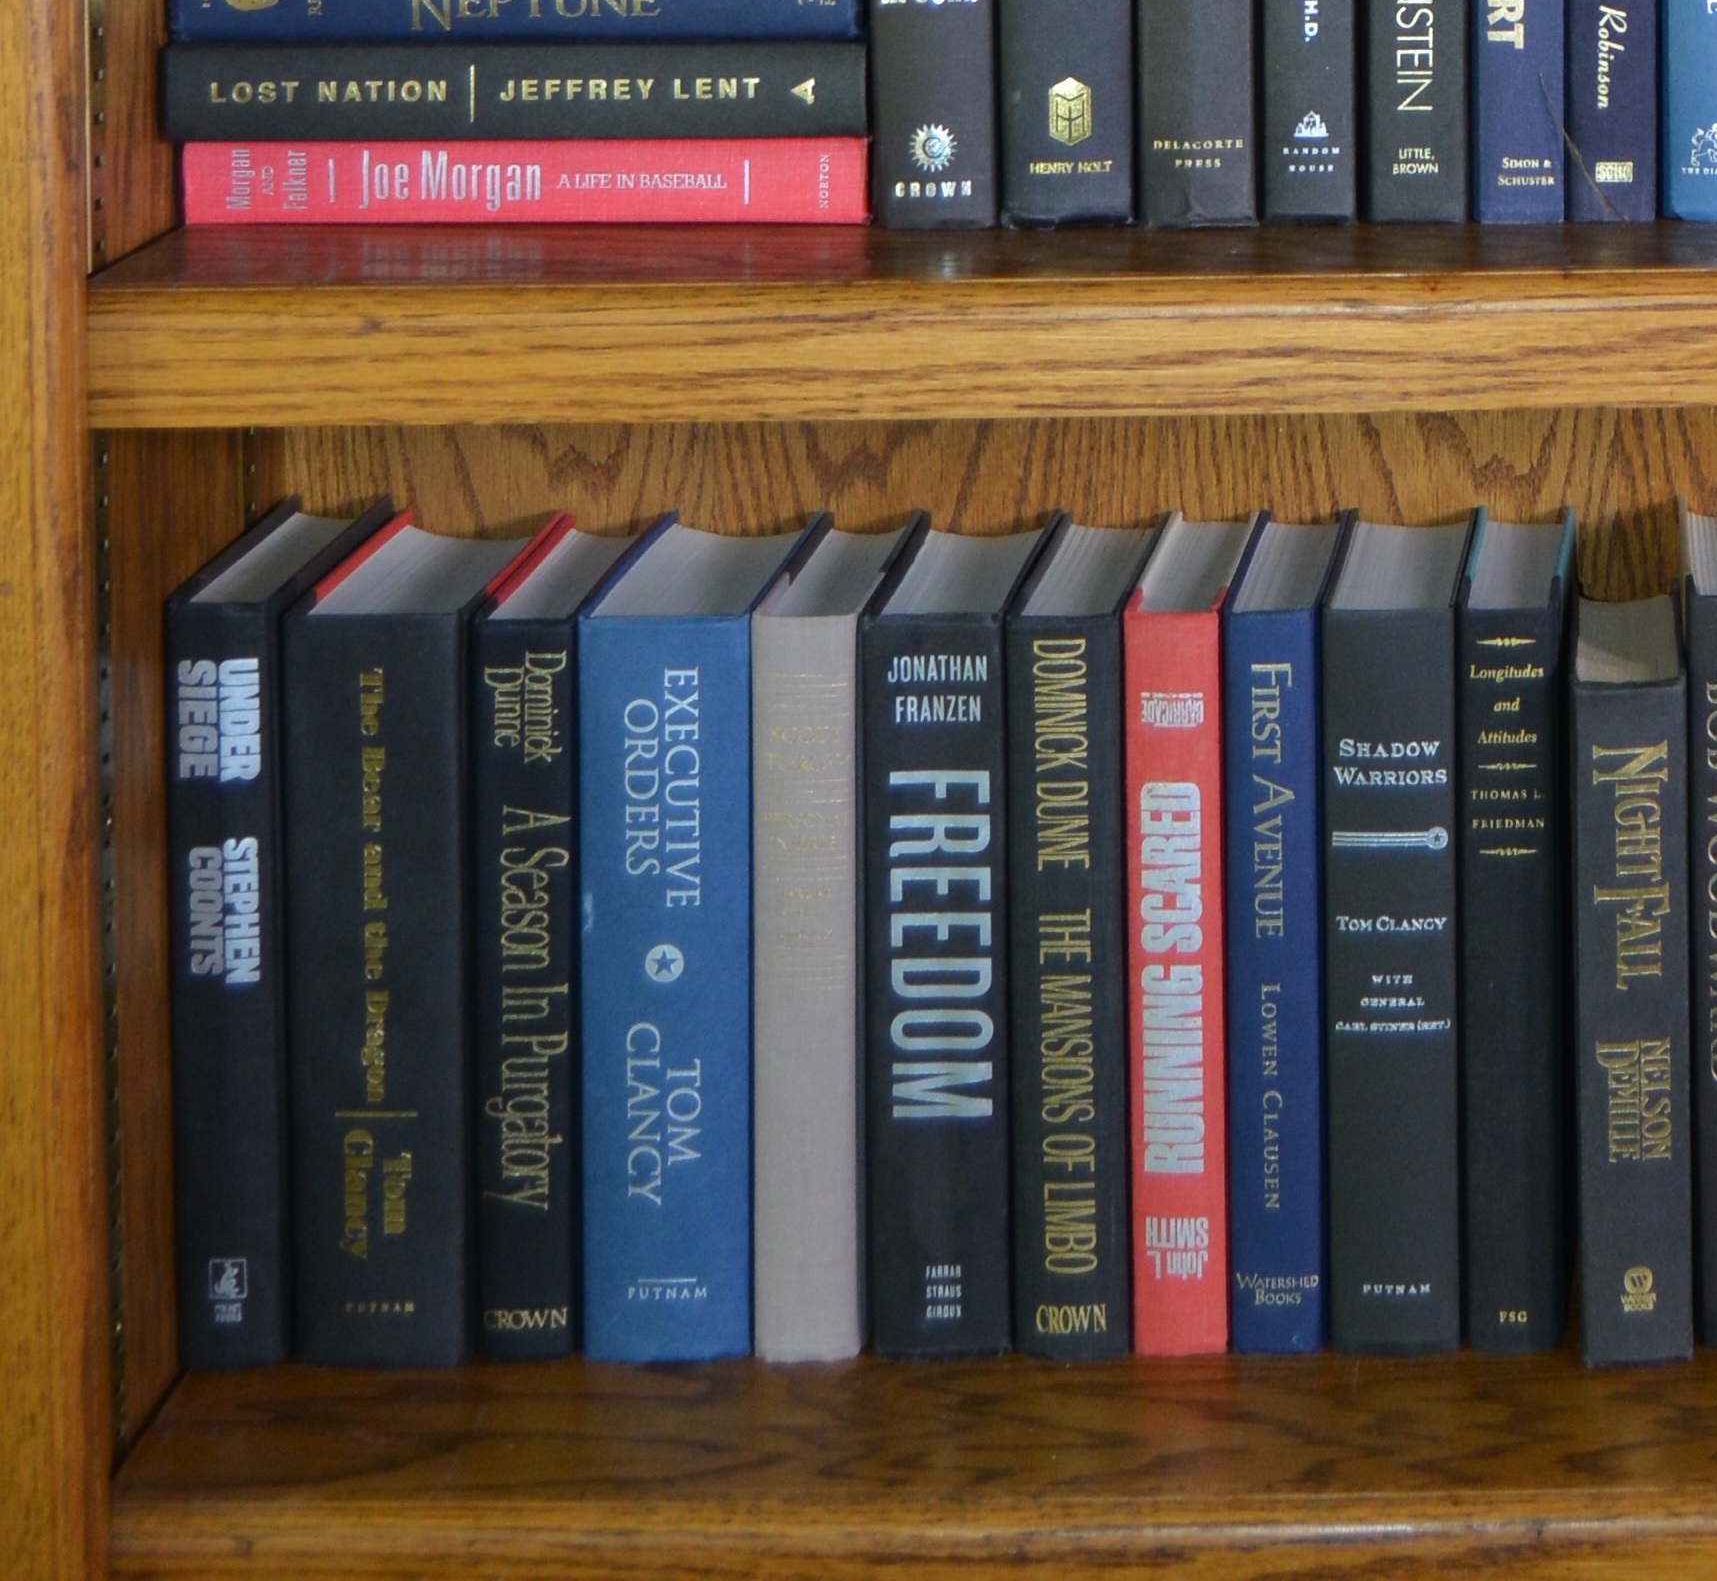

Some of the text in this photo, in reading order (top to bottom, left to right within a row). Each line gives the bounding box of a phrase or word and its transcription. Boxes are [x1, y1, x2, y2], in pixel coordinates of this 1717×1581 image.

[888, 655, 987, 683] JONATHAN
[896, 695, 980, 723] FRANZEN
[1470, 664, 1543, 683] Longitudes
[1494, 697, 1520, 711] and
[624, 699, 660, 875] ORDERS
[664, 667, 700, 907] EXECUTIVE
[1478, 729, 1537, 744] Attitudes
[889, 770, 994, 1118] FREEDOM
[1140, 782, 1204, 1173] RUNNING SCARED
[626, 1022, 661, 1206] CLANCY
[667, 1058, 701, 1166] TOM
